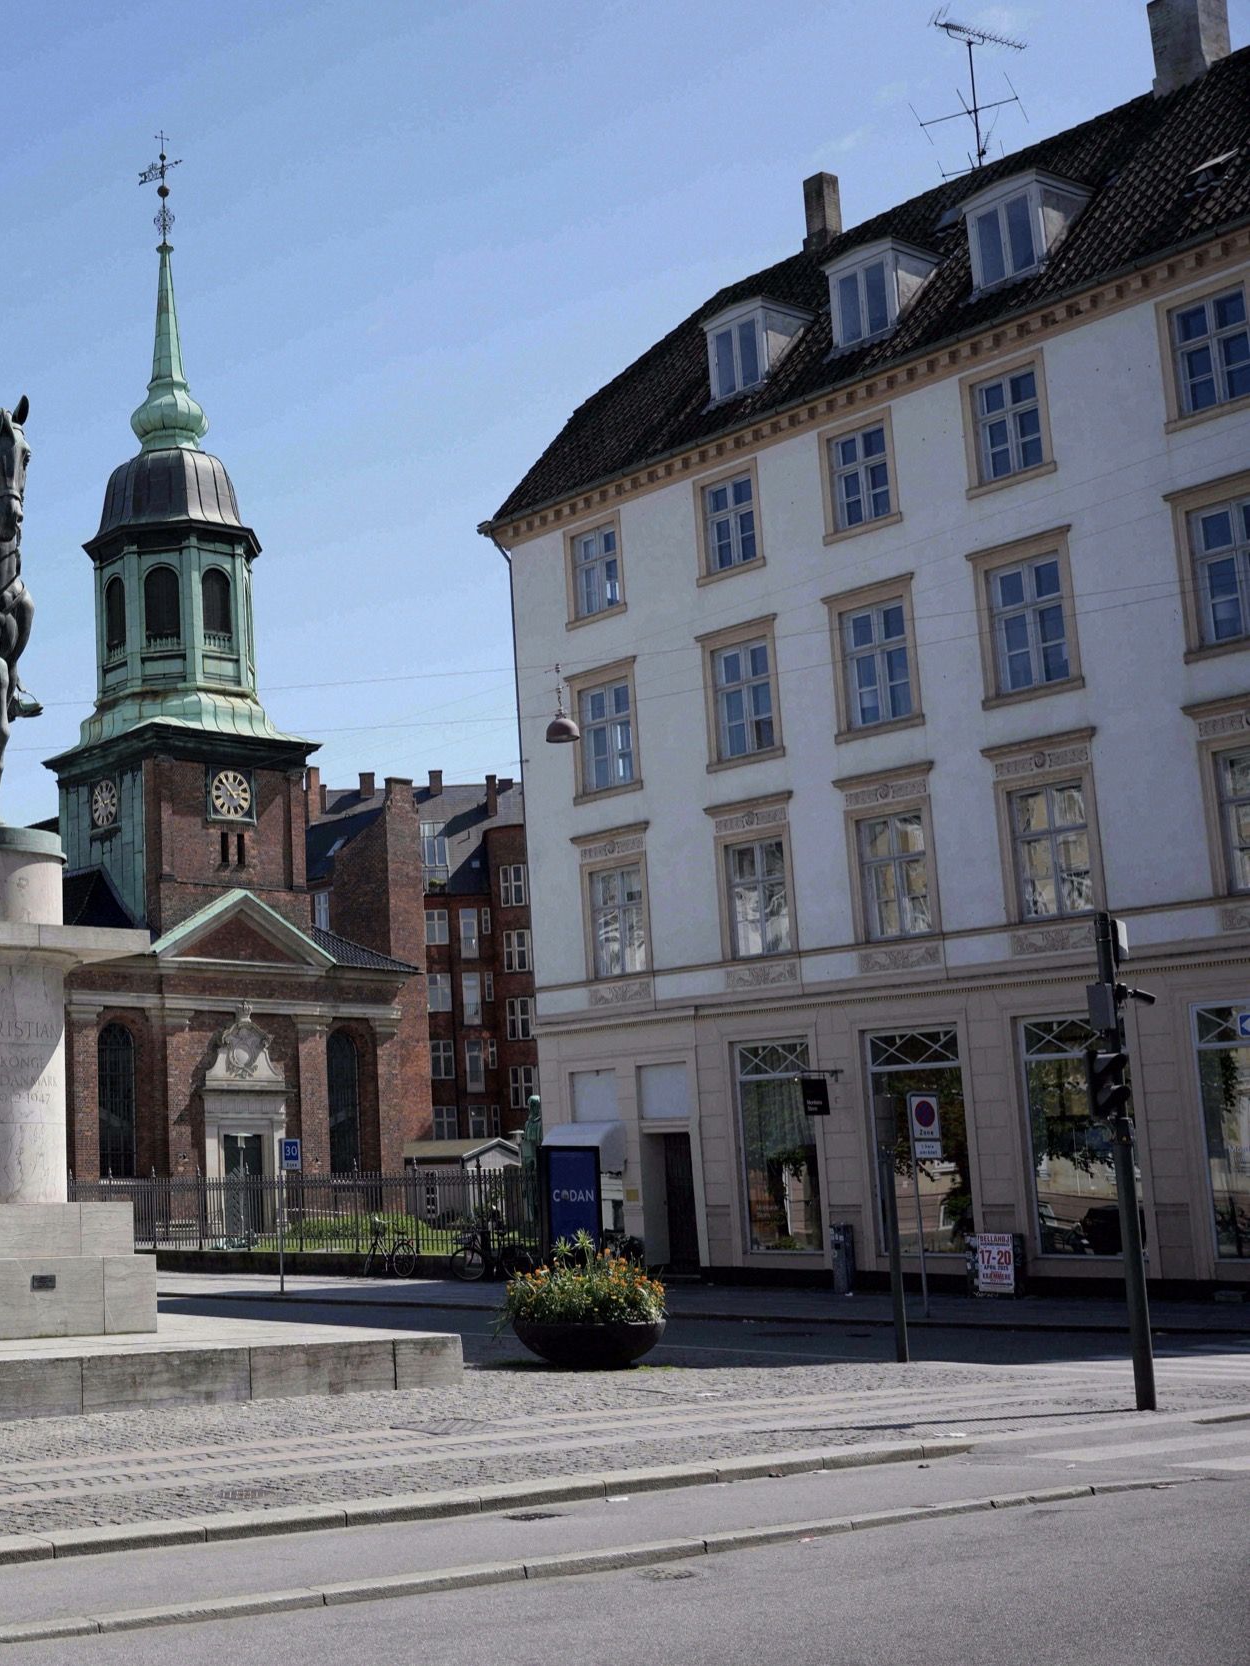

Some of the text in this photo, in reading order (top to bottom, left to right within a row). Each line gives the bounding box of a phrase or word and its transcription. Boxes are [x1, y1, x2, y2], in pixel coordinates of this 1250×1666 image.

[0, 1075, 58, 1088] DANMARK
[285, 1145, 298, 1157] 30
[552, 1189, 595, 1202] CODAN
[980, 1250, 1012, 1265] 17-20
